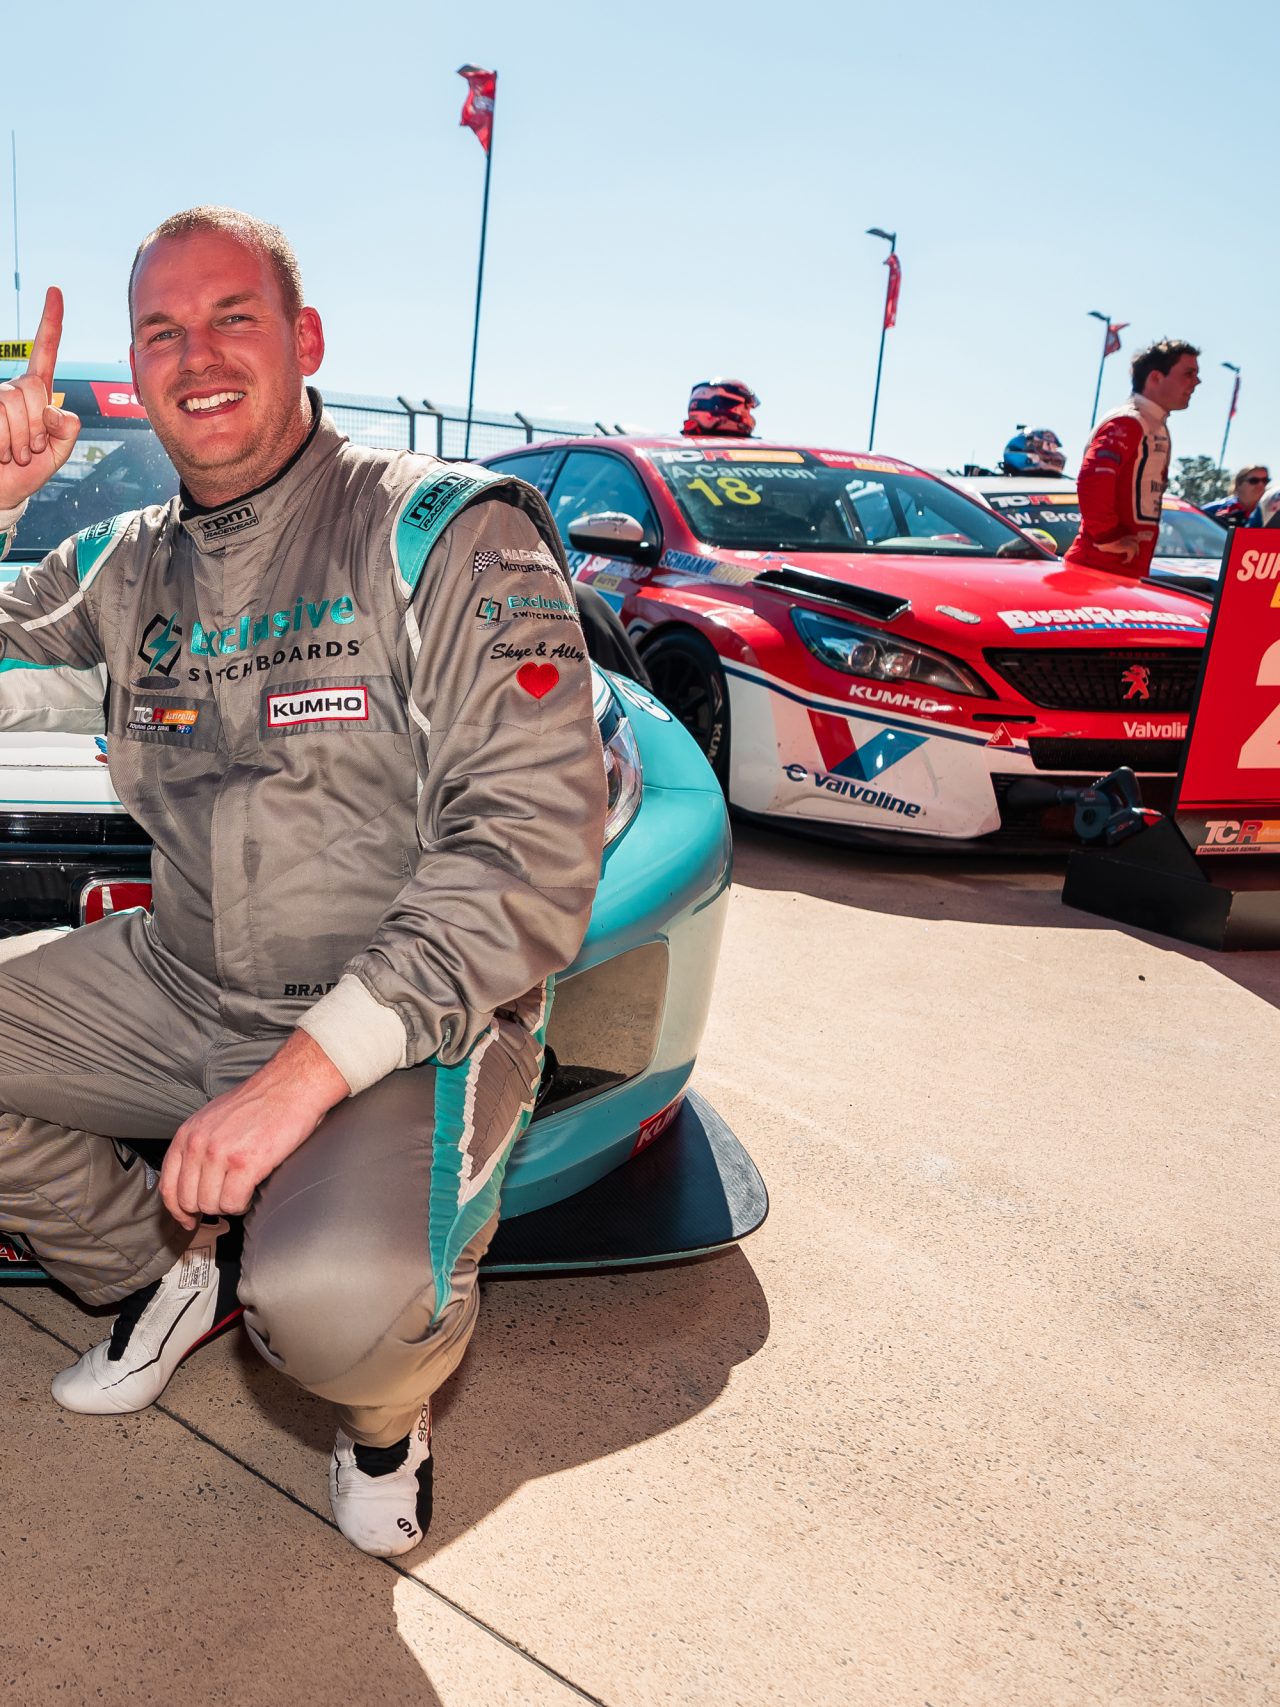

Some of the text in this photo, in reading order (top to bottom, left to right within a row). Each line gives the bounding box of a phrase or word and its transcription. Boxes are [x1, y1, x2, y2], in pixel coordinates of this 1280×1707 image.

[671, 464, 817, 480] A.Cameron
[409, 475, 462, 521] rpm
[423, 479, 473, 528] RACEWEAR
[686, 477, 762, 506] 18
[202, 506, 252, 530] rpm
[206, 520, 257, 538] RACEWEAR
[188, 639, 360, 685] STCHBOARDS
[490, 641, 585, 661] Skye & Ally
[273, 696, 362, 718] KUMHO
[849, 684, 940, 713] KUMHO
[134, 706, 165, 723] TCR
[990, 729, 1004, 745] TOW
[1205, 820, 1263, 844] TCR
